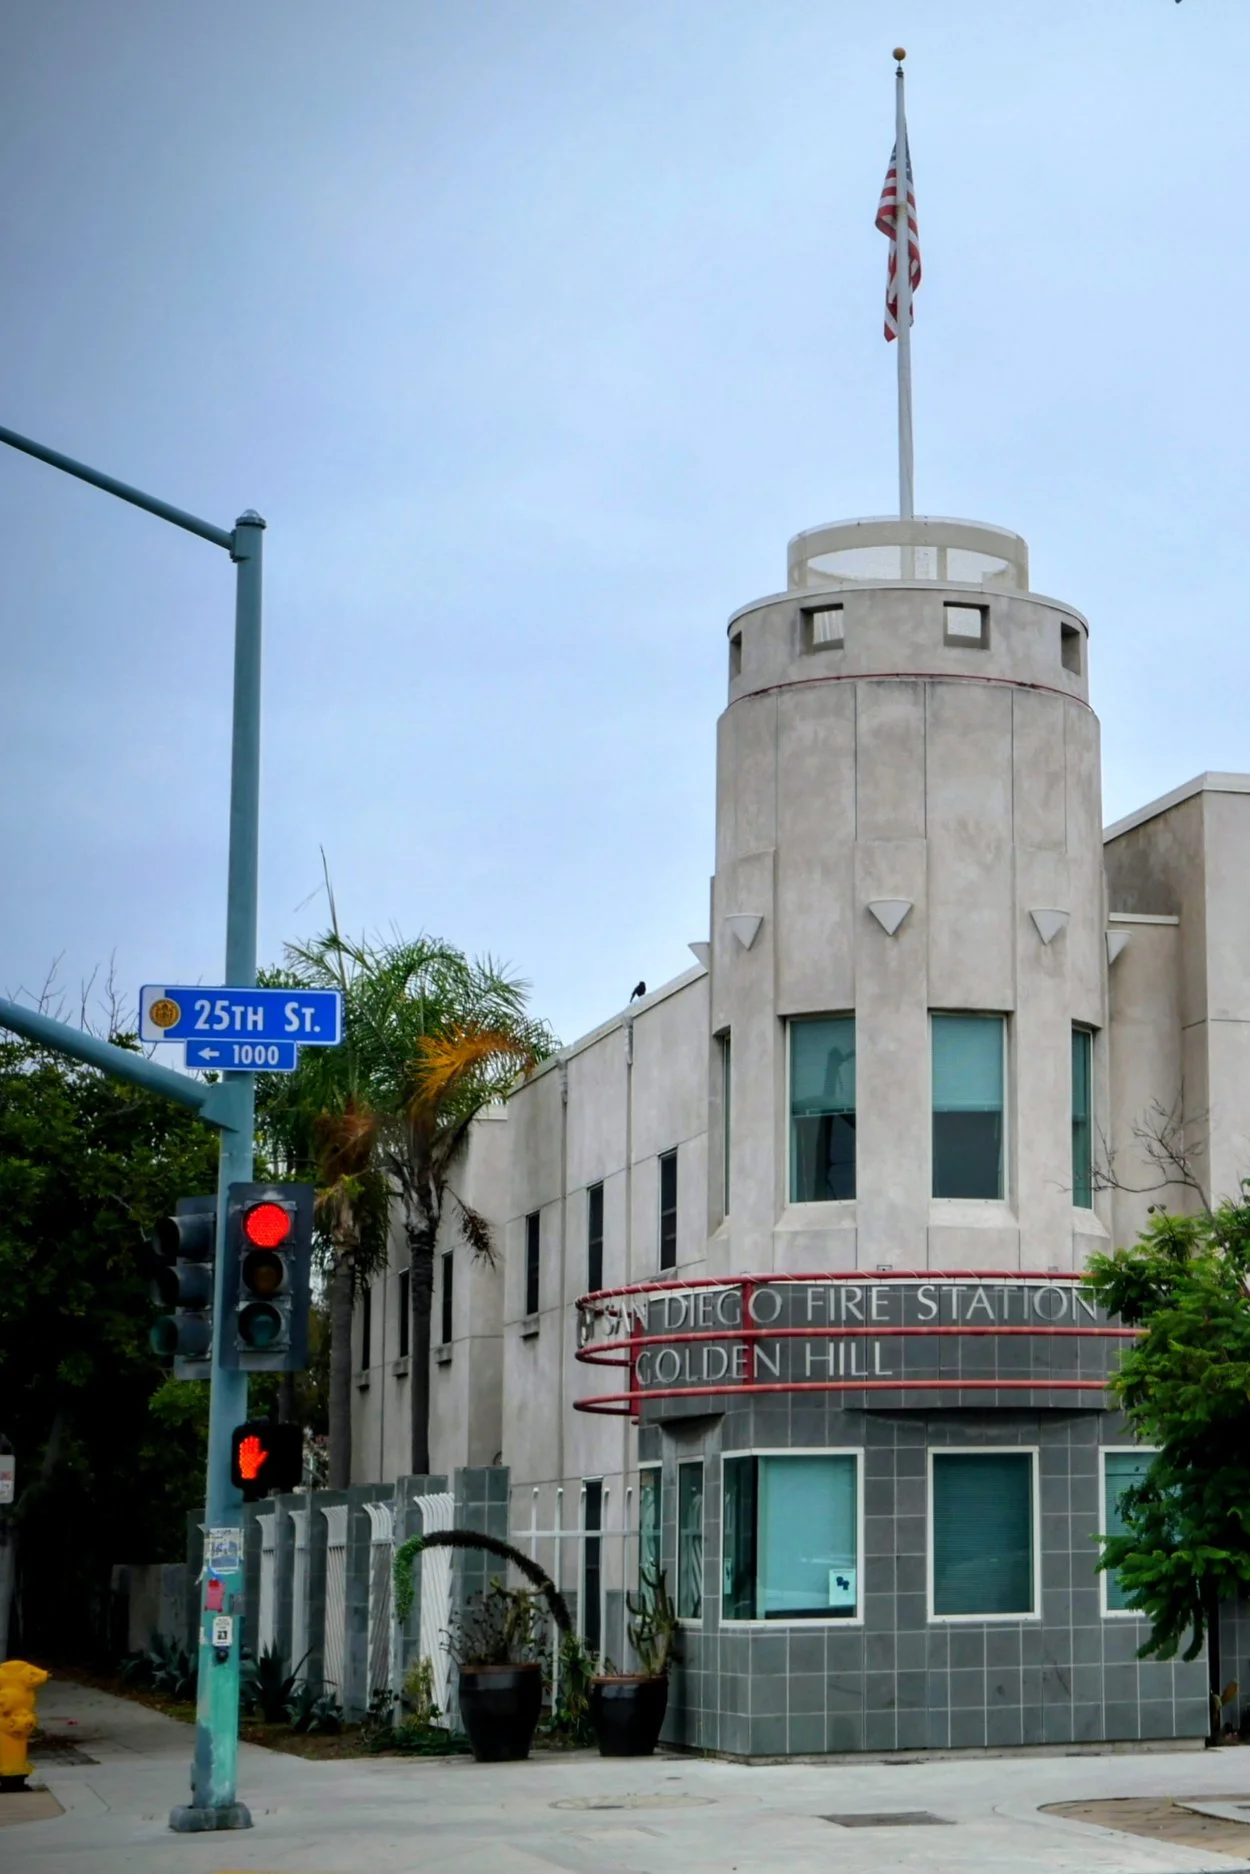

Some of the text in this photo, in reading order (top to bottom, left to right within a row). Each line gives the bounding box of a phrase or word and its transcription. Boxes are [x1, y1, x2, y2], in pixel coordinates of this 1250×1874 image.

[194, 999, 264, 1031] 25TH
[233, 1044, 280, 1065] 1000
[602, 1299, 649, 1337] SAN
[663, 1287, 783, 1330] DIEGO
[806, 1286, 890, 1321] FIRE
[916, 1284, 1098, 1321] STATION
[635, 1341, 893, 1385] GOLDEN HILL
